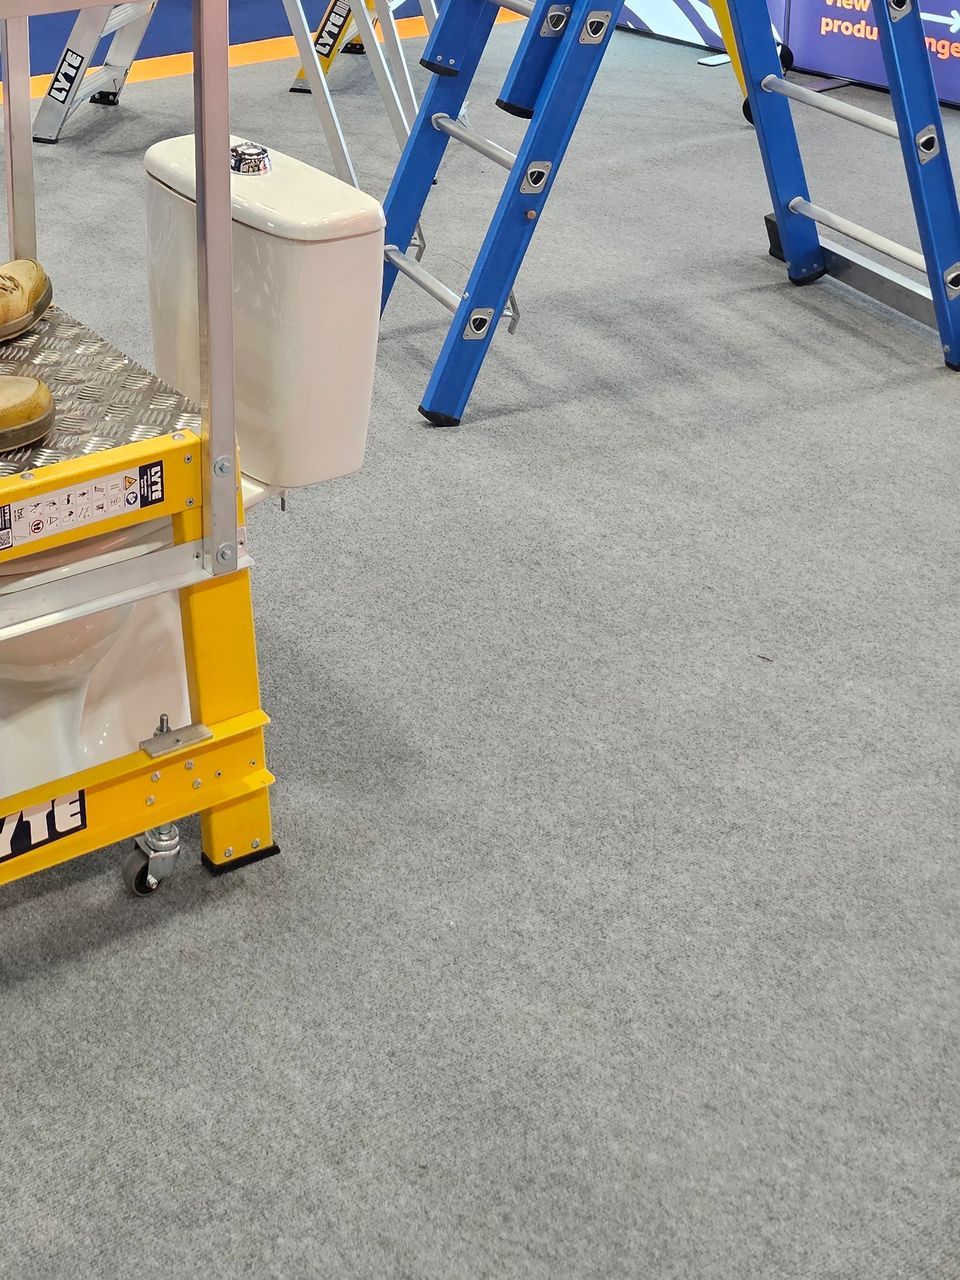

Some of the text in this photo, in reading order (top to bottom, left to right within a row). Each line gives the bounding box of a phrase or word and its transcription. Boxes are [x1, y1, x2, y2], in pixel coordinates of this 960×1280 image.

[316, 12, 344, 55] LYTE
[820, 17, 960, 59] produ nge
[50, 51, 82, 101] LYTE
[150, 465, 162, 500] LYTE
